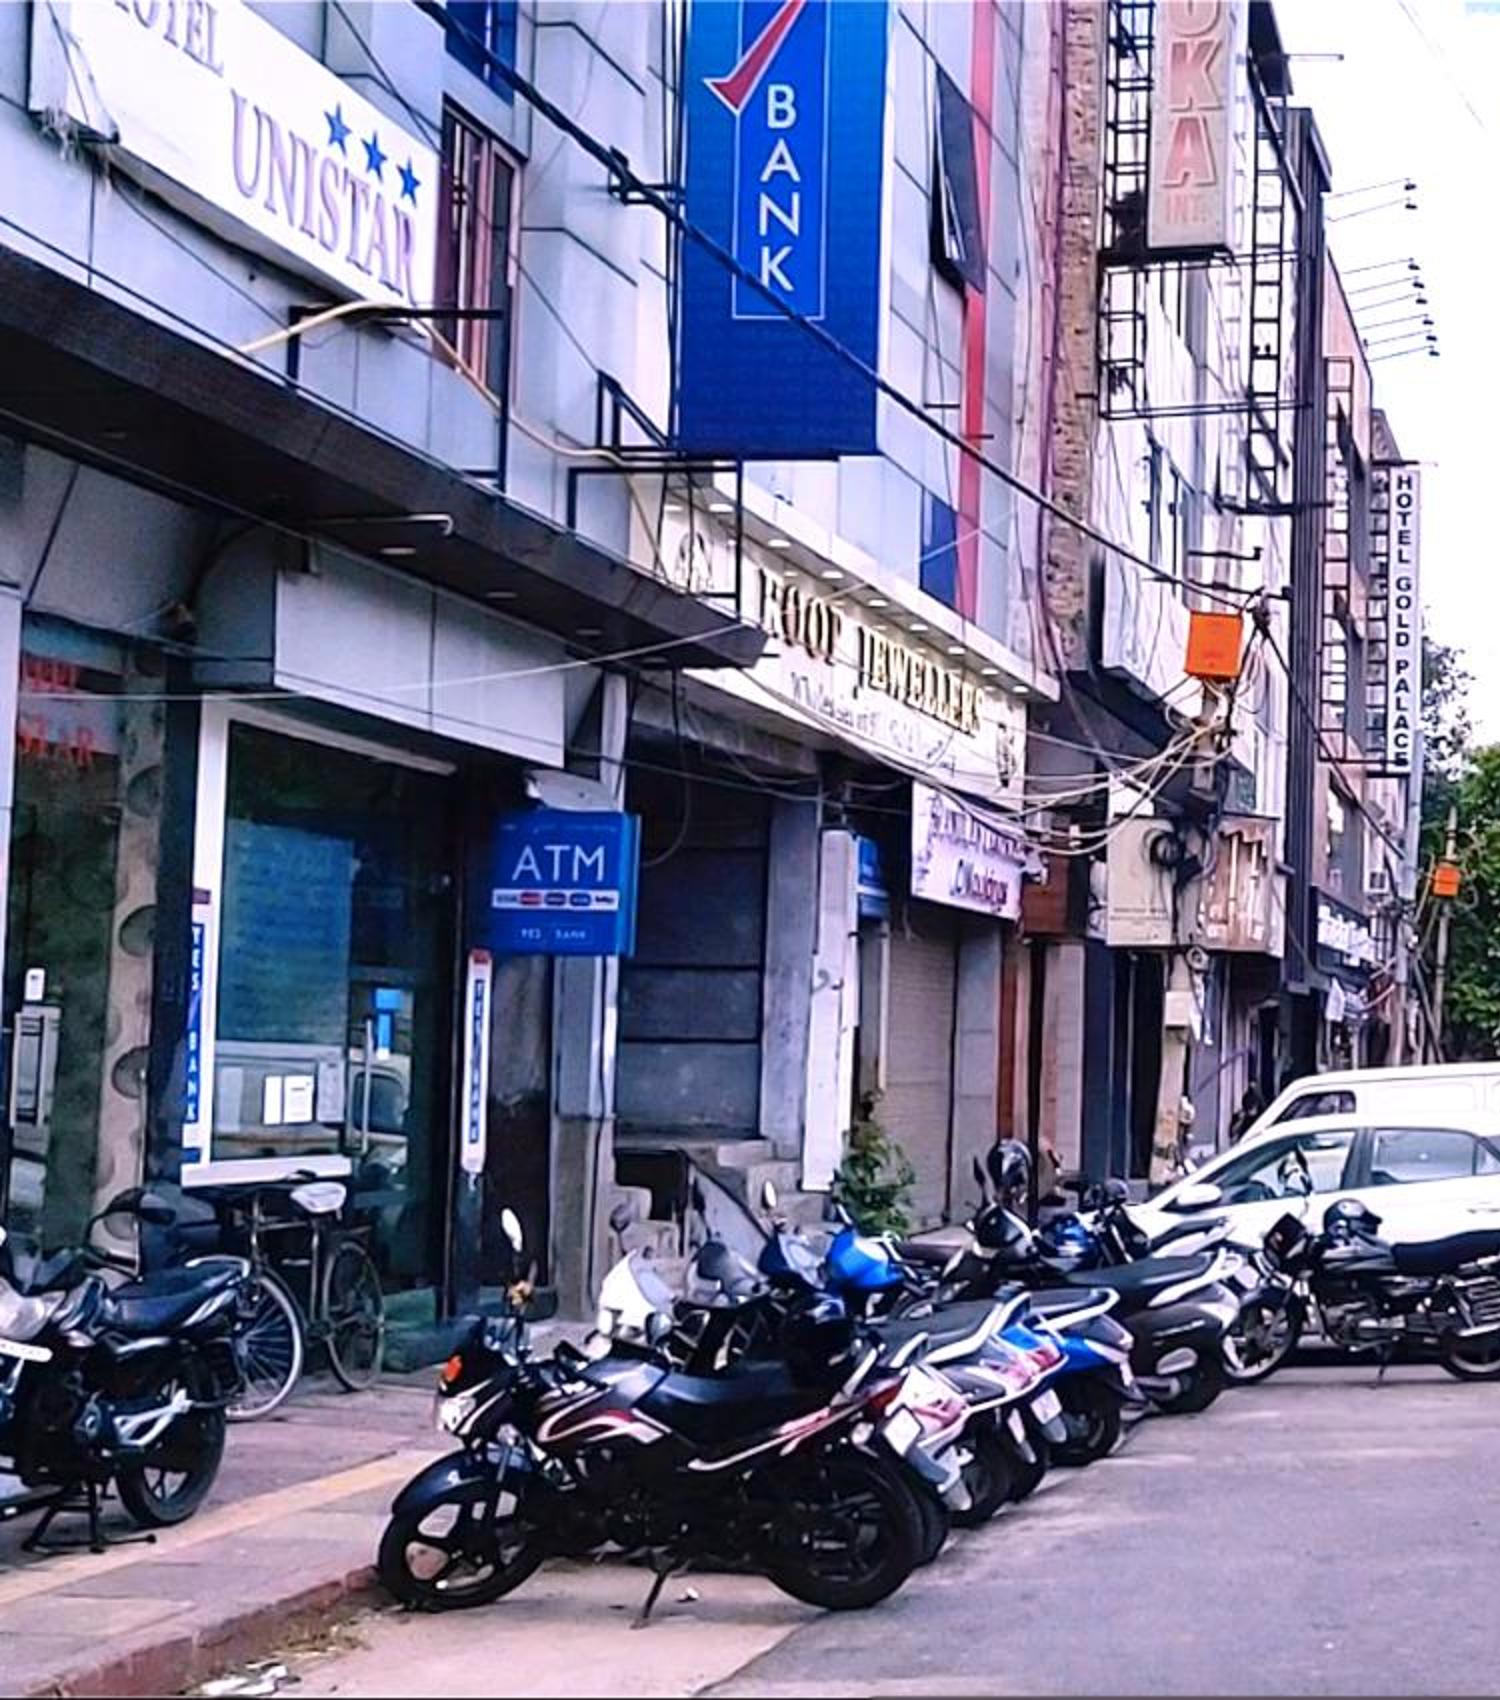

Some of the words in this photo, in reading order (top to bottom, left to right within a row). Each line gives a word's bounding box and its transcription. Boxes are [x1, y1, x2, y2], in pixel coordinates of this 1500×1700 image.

[231, 88, 417, 306] UNISTAR
[759, 84, 801, 292] BANK
[1396, 475, 1413, 564] HOTEL
[1396, 577, 1412, 647] GOLD
[853, 625, 985, 738] JEWELLERS
[1394, 659, 1410, 766] PALACE
[511, 844, 605, 882] ATM
